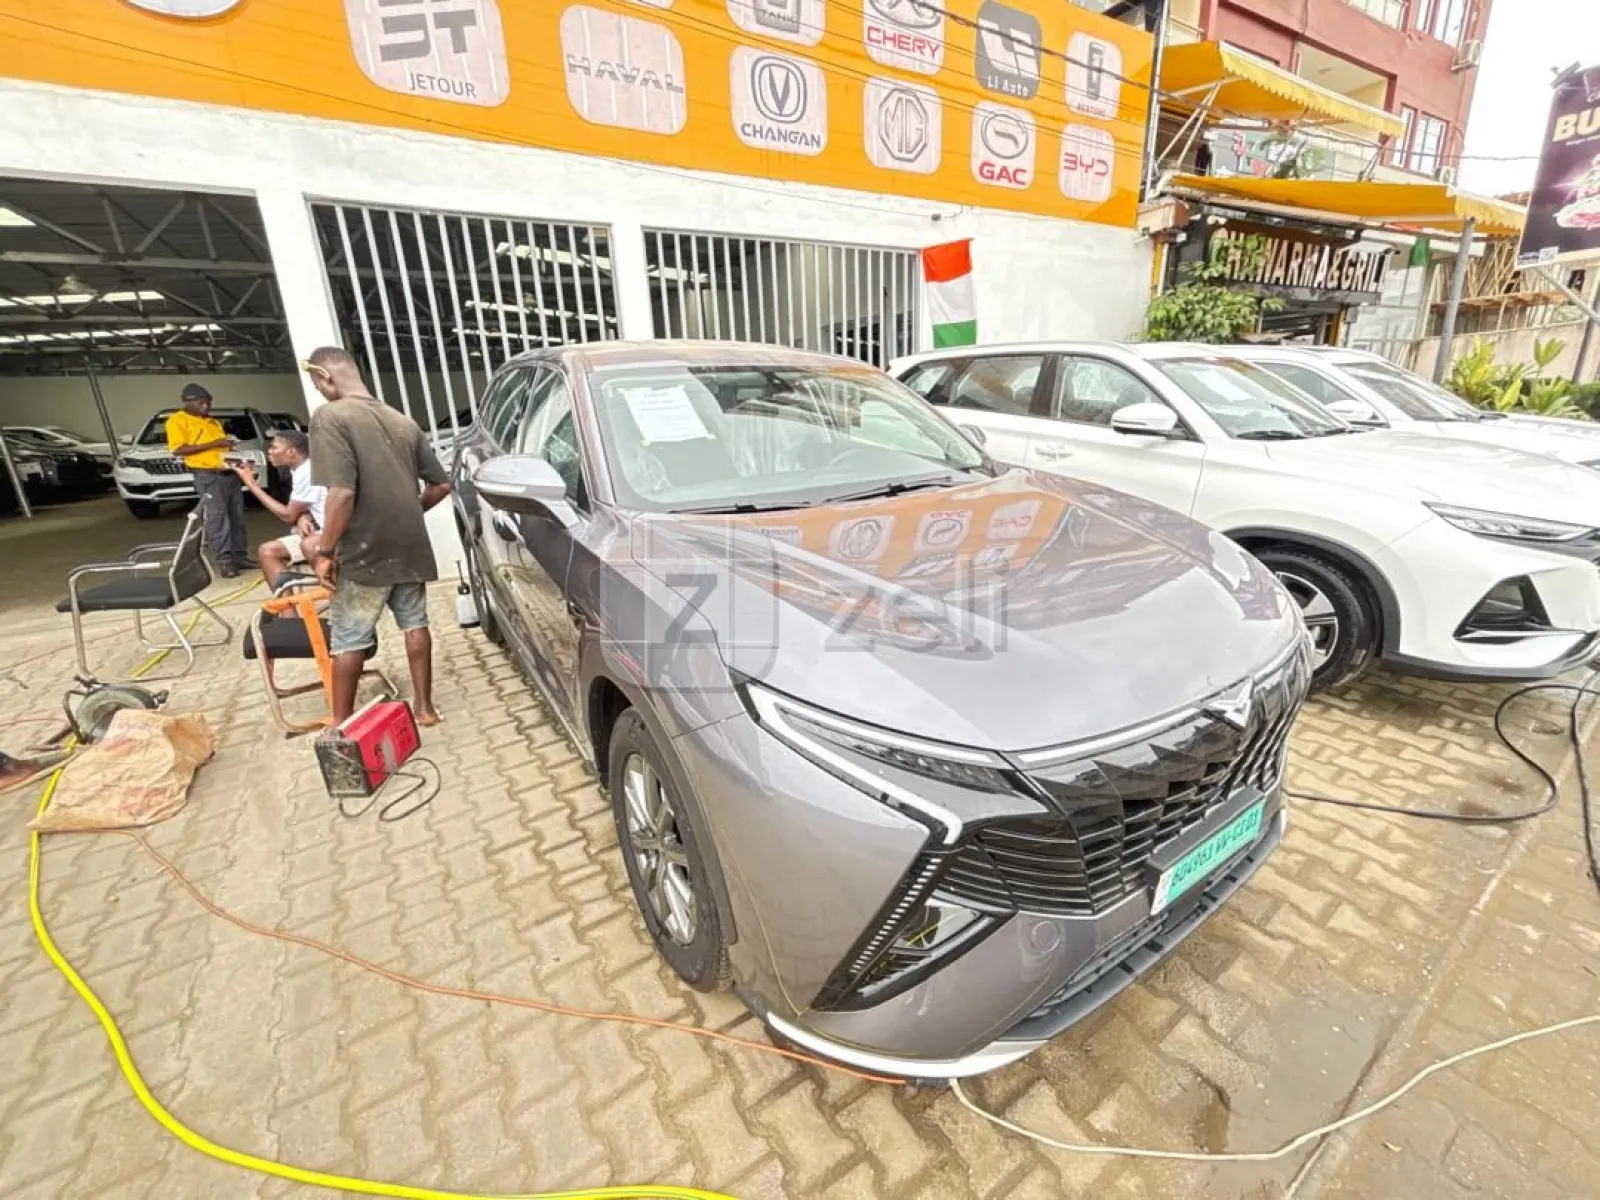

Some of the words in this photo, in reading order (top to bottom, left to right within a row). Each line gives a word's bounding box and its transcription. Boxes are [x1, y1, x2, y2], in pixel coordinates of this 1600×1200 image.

[867, 25, 940, 59] CHERY
[409, 72, 477, 99] JETOUR
[567, 54, 683, 93] HAVAL
[740, 123, 821, 149] CHANGAN
[883, 96, 924, 155] MG
[978, 160, 1028, 186] GAC
[1063, 152, 1109, 176] BYD
